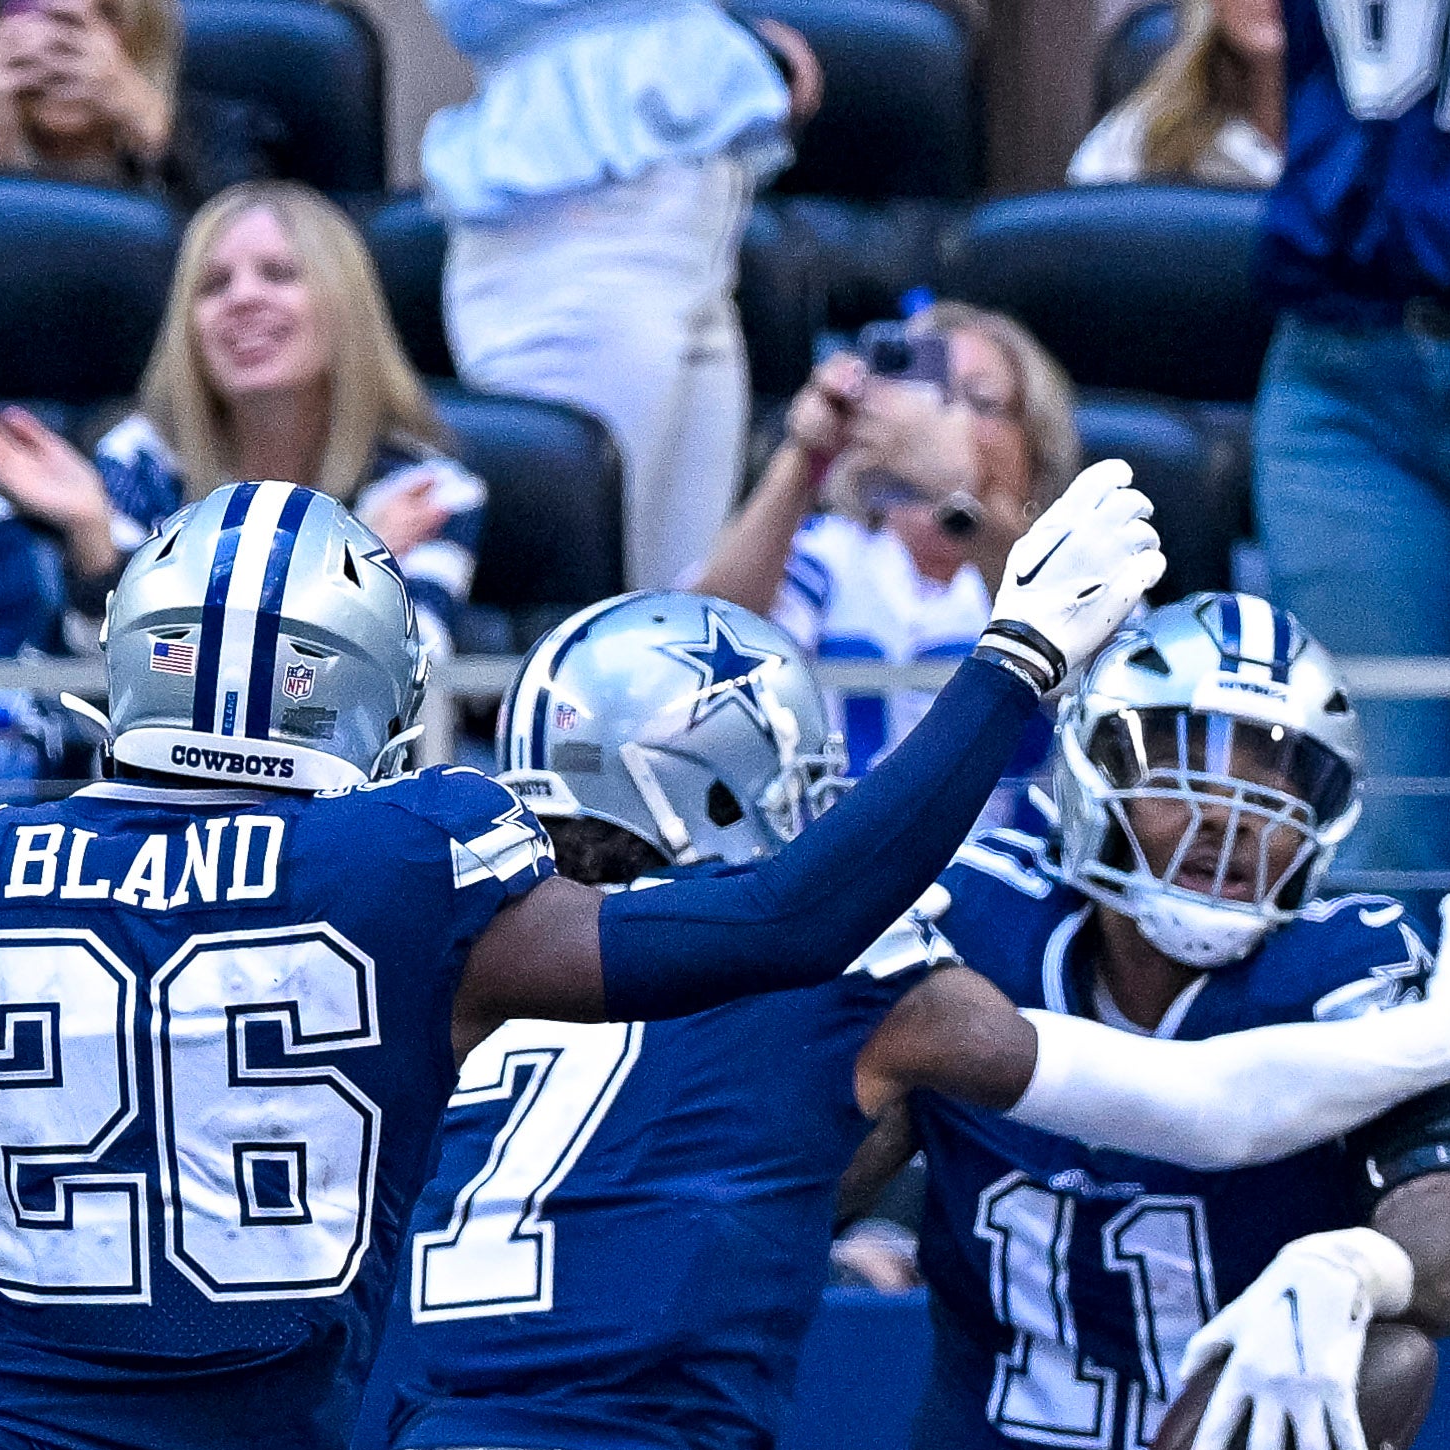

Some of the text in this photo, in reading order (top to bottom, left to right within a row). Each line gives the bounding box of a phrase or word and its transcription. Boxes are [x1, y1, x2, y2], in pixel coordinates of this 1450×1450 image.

[170, 744, 295, 779] COWBOYS
[4, 814, 284, 910] BLAND
[412, 1020, 644, 1325] 7
